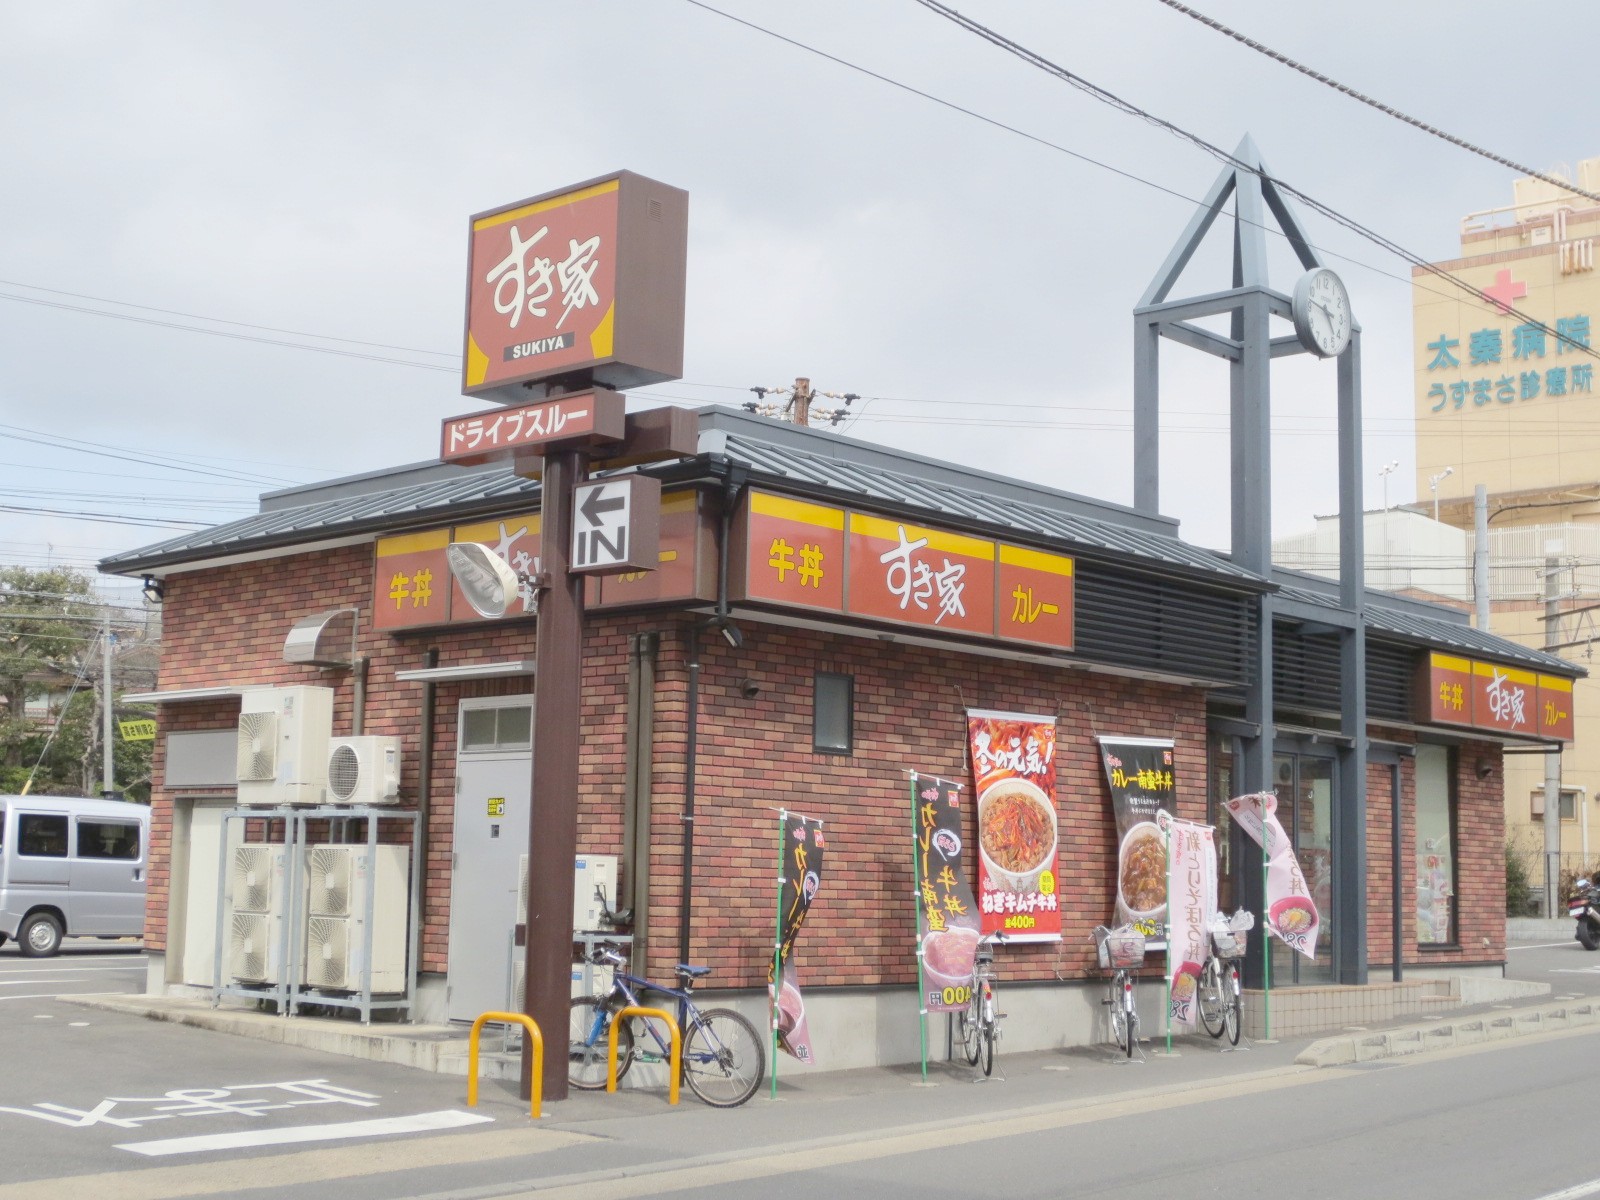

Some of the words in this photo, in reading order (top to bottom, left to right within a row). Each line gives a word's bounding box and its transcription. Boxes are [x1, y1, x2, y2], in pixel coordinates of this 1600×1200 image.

[486, 225, 600, 329] すき家
[512, 336, 564, 359] SUKIYA
[1427, 313, 1592, 370] 太秦病院
[450, 405, 588, 452] ドライブスルー
[578, 526, 626, 566] IN
[768, 538, 824, 588] 牛丼
[389, 567, 433, 610] 牛丼
[879, 524, 966, 625] すき家
[1012, 584, 1059, 624] カレー
[1439, 681, 1464, 711] 牛丼
[1486, 667, 1526, 730] すき家
[1545, 700, 1567, 726] カレー
[975, 731, 1053, 775] 冬の元気!
[1111, 769, 1173, 791] カレー南蛮牛丼
[982, 892, 1057, 914] ねぎキムチ牛丼
